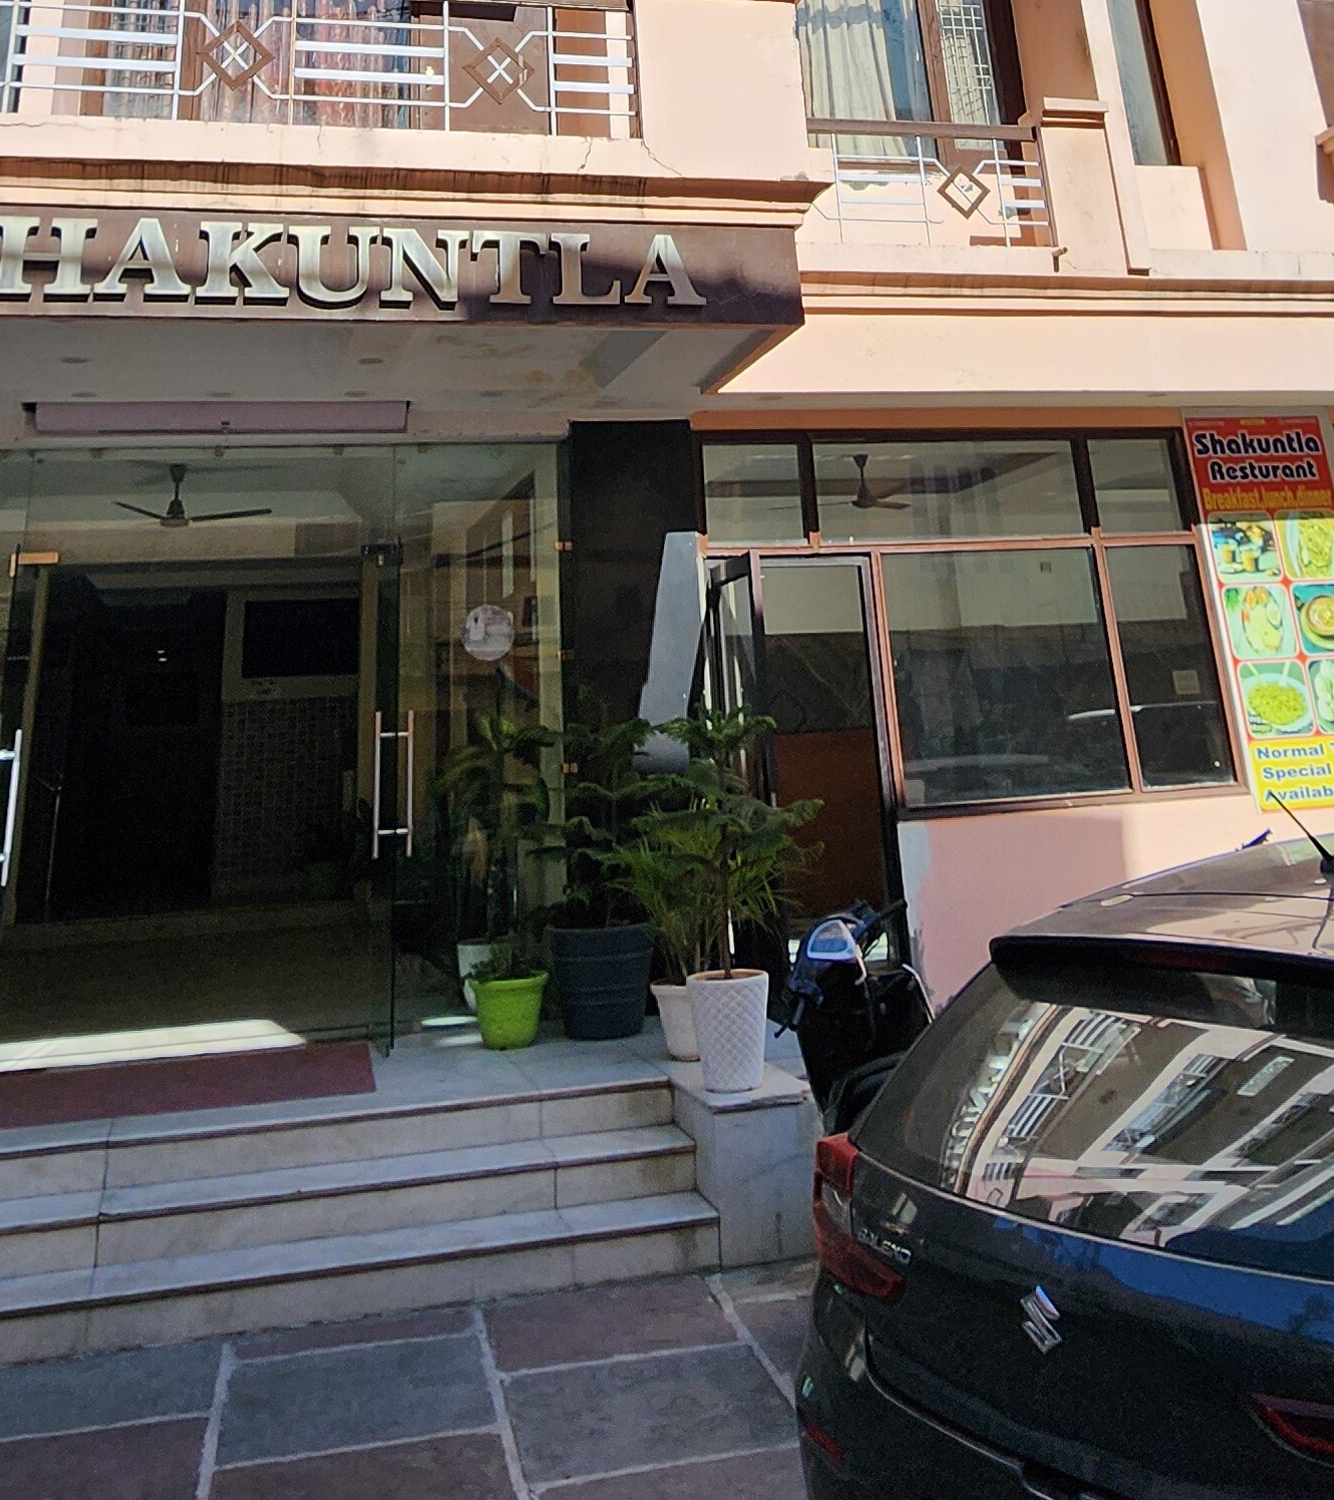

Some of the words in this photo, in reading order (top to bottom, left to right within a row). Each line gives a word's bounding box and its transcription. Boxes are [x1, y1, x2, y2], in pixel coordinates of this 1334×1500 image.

[1193, 430, 1321, 456] Shakuntla
[1209, 459, 1317, 481] Resturant
[1256, 743, 1325, 760] Normal
[1262, 762, 1332, 781] Special
